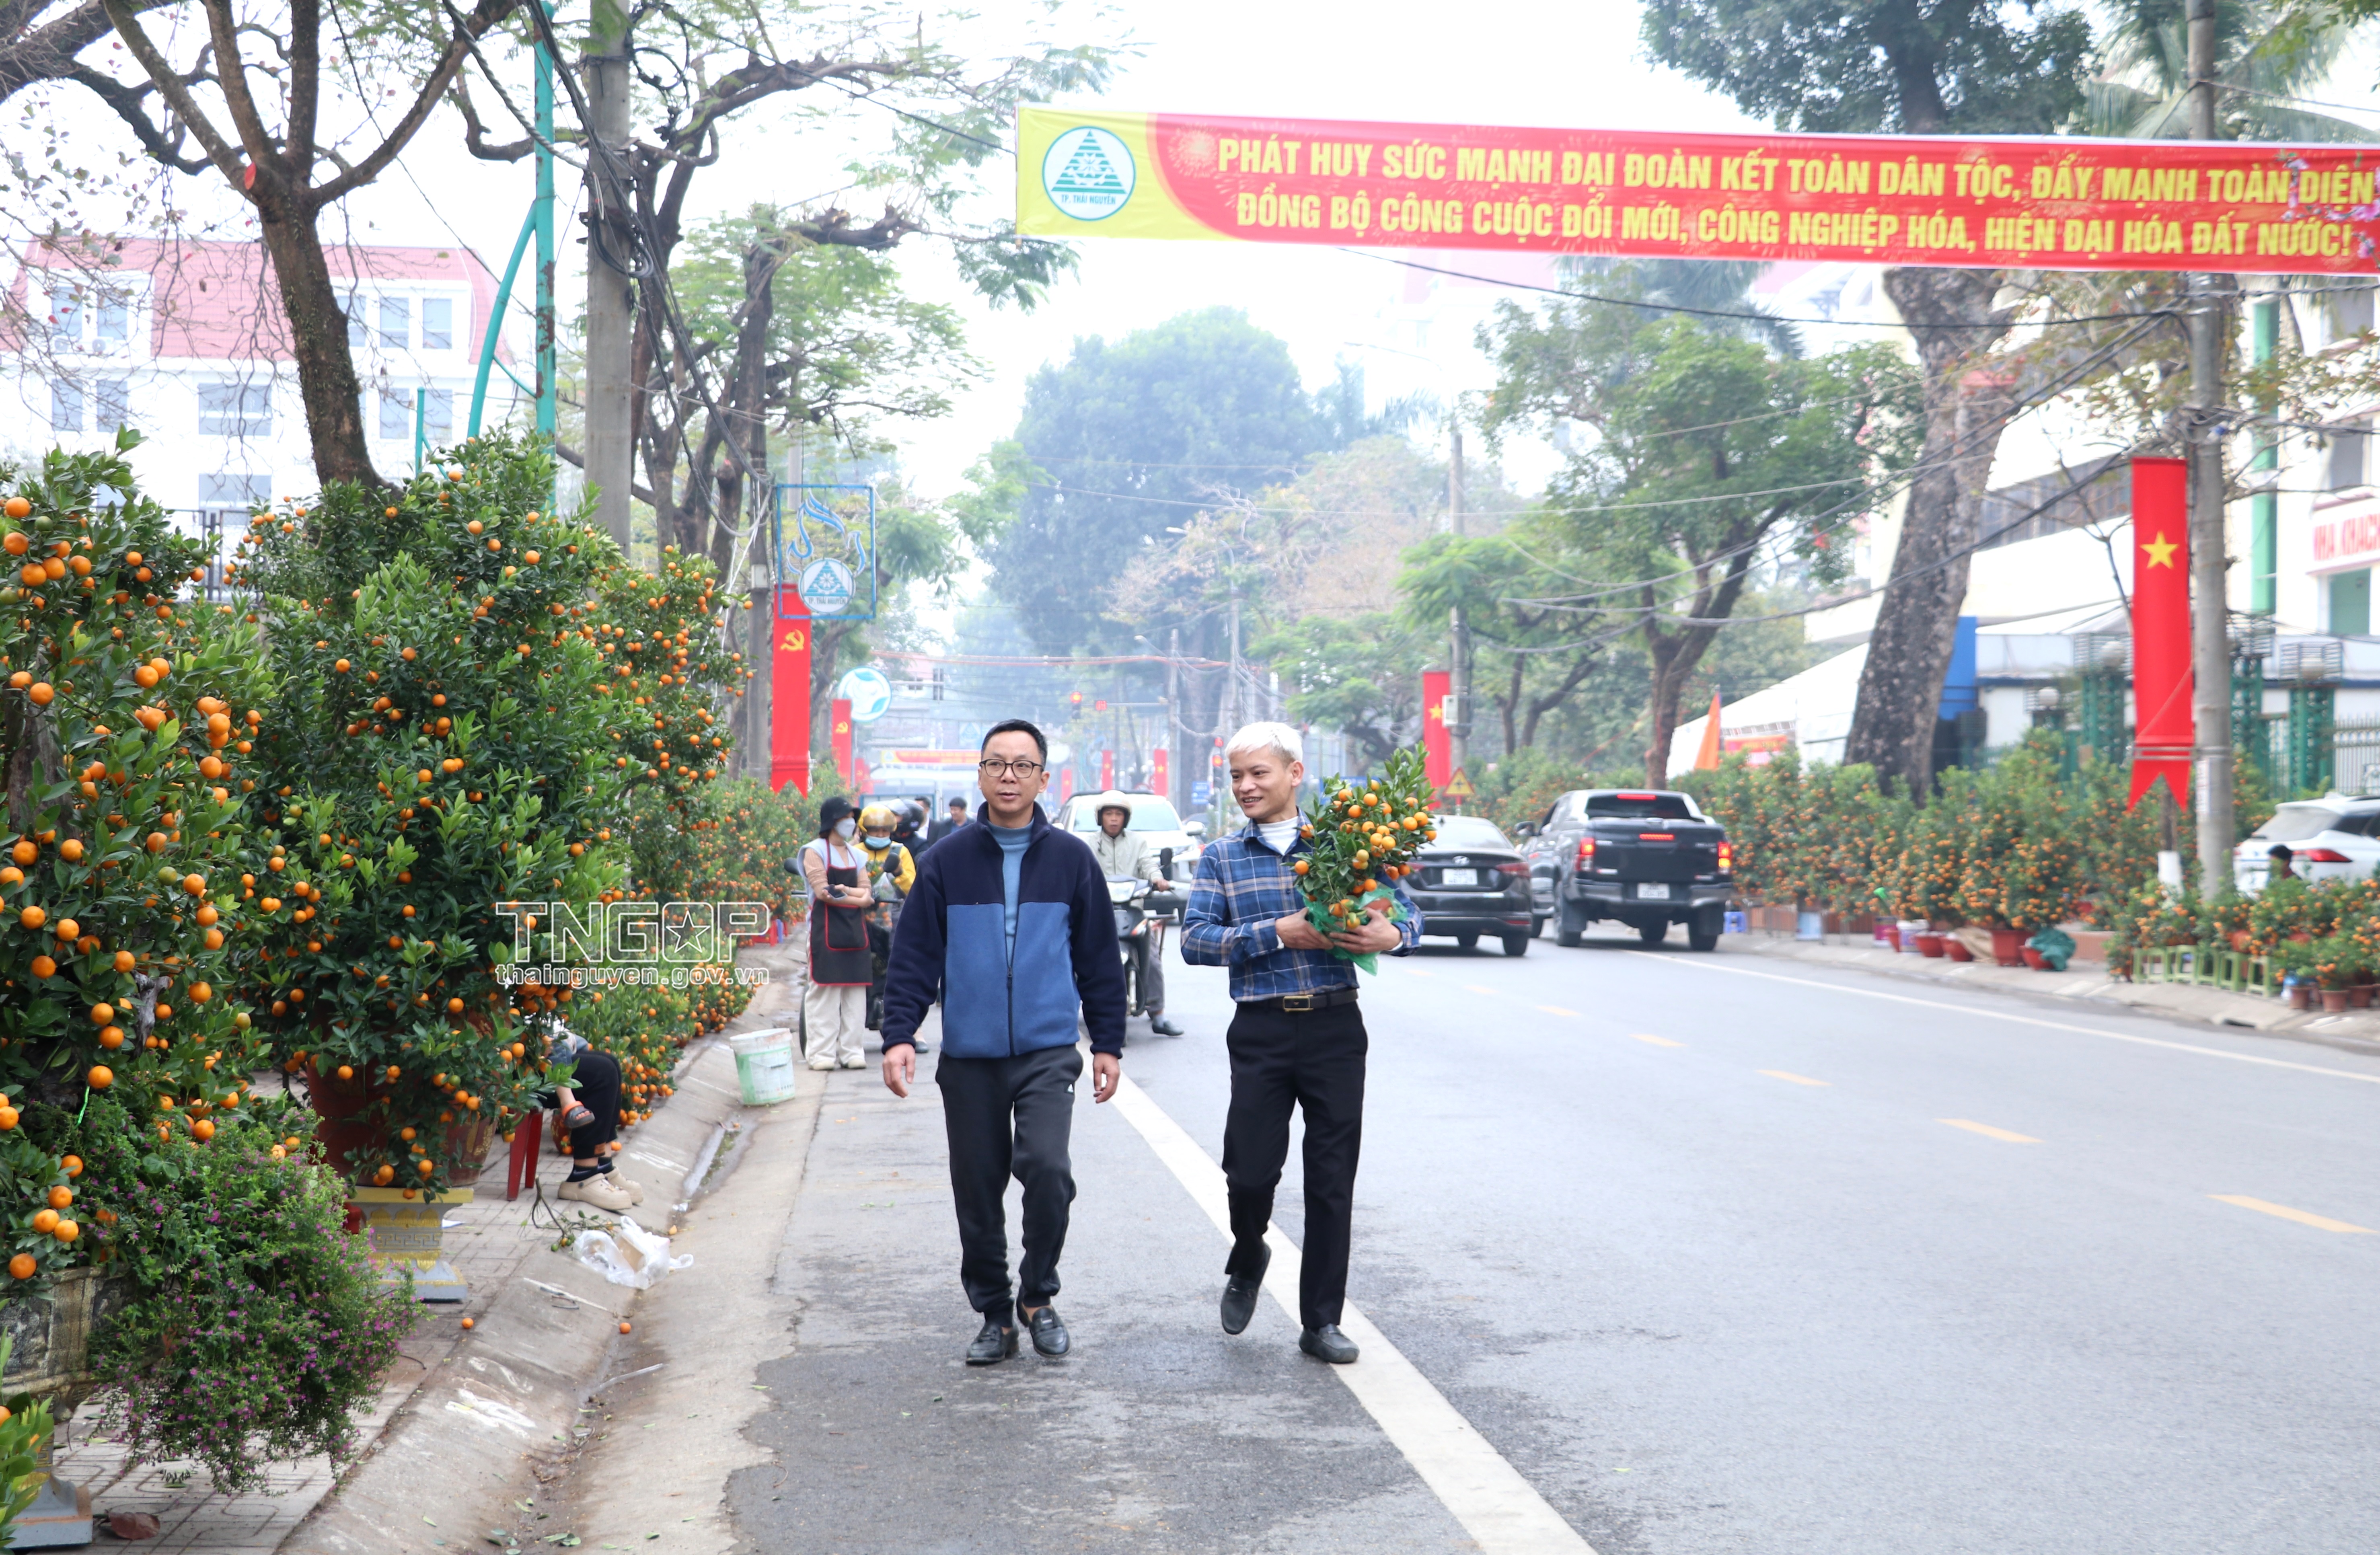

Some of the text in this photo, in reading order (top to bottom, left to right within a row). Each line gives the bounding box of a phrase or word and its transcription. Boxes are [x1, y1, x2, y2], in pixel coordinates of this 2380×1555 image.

[1061, 193, 1116, 205] TP. THÁI NGUYÊN
[1219, 134, 2374, 211] PHÁT HUY SỨC MẠNH ĐẠI ĐOÀN KẾT TOÀN DÂN TỘC, ĐẨY MẠNH TOÀN DIỆN
[1237, 182, 2352, 260] ĐỒNG BỘ CÔNG CUỘC ĐỔI MỚI, CÔNG NGHIỆP HÓA, HIỆN ĐẠI HÓA ĐẤT NƯỚC!
